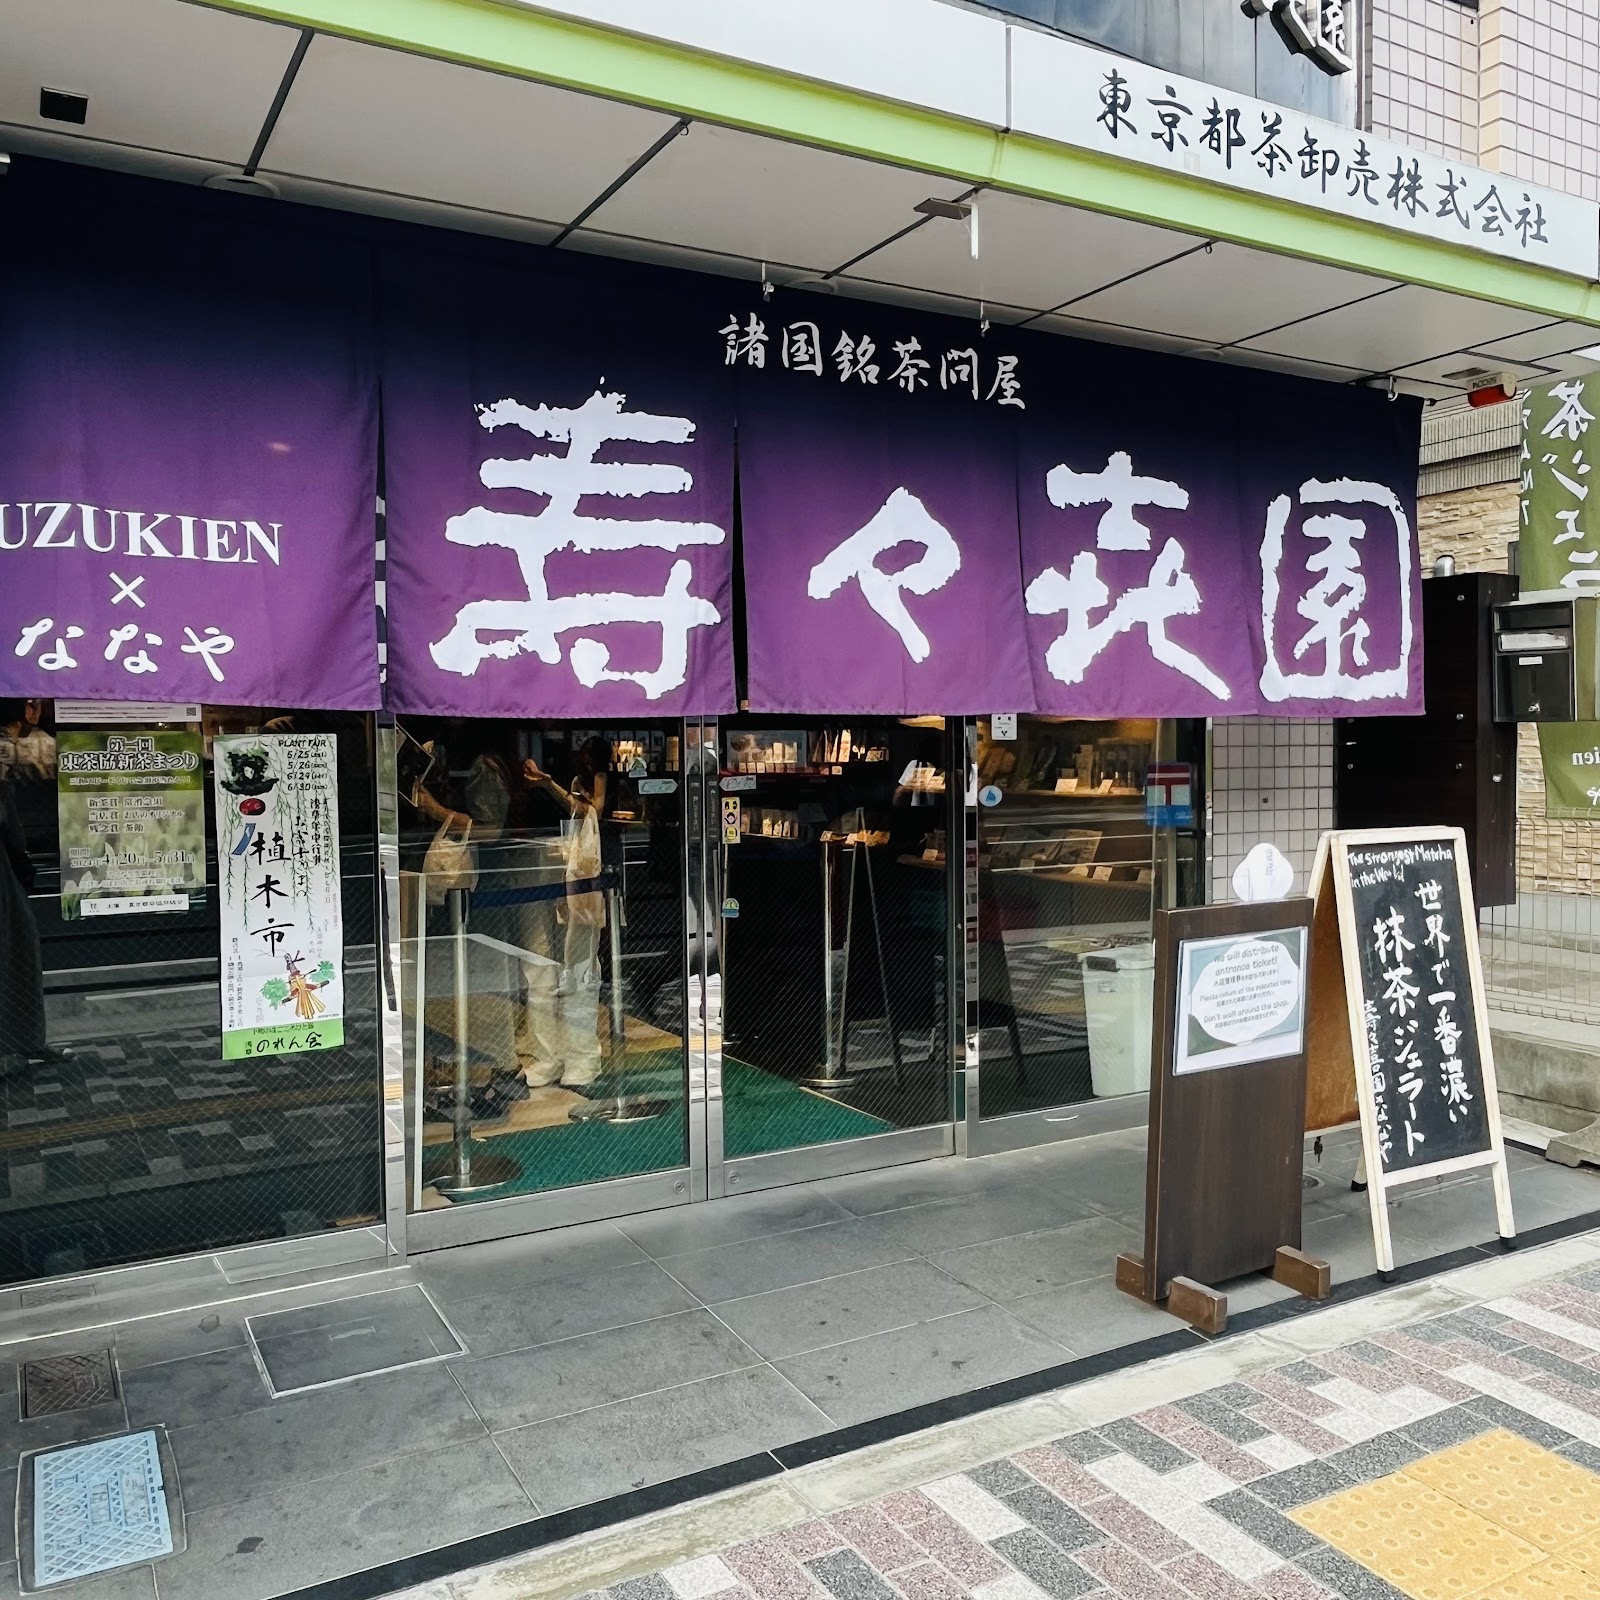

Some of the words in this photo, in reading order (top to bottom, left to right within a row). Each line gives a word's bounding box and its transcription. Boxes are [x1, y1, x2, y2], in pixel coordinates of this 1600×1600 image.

[1096, 68, 1549, 249] 東京都茶卸売株式会社
[718, 312, 1026, 409] 諸国銘茶問屋
[0, 503, 283, 566] UZUKIEN
[15, 618, 235, 682] ななや
[250, 832, 295, 957] 植木市
[1347, 852, 1364, 867] The
[1414, 844, 1454, 862] Matcha
[1350, 872, 1361, 888] in
[1360, 871, 1376, 887] the
[1373, 906, 1425, 1157] 抹茶ジェラート
[1414, 879, 1474, 1123] 世界で一番濃い
[256, 1031, 322, 1053] のれん会
